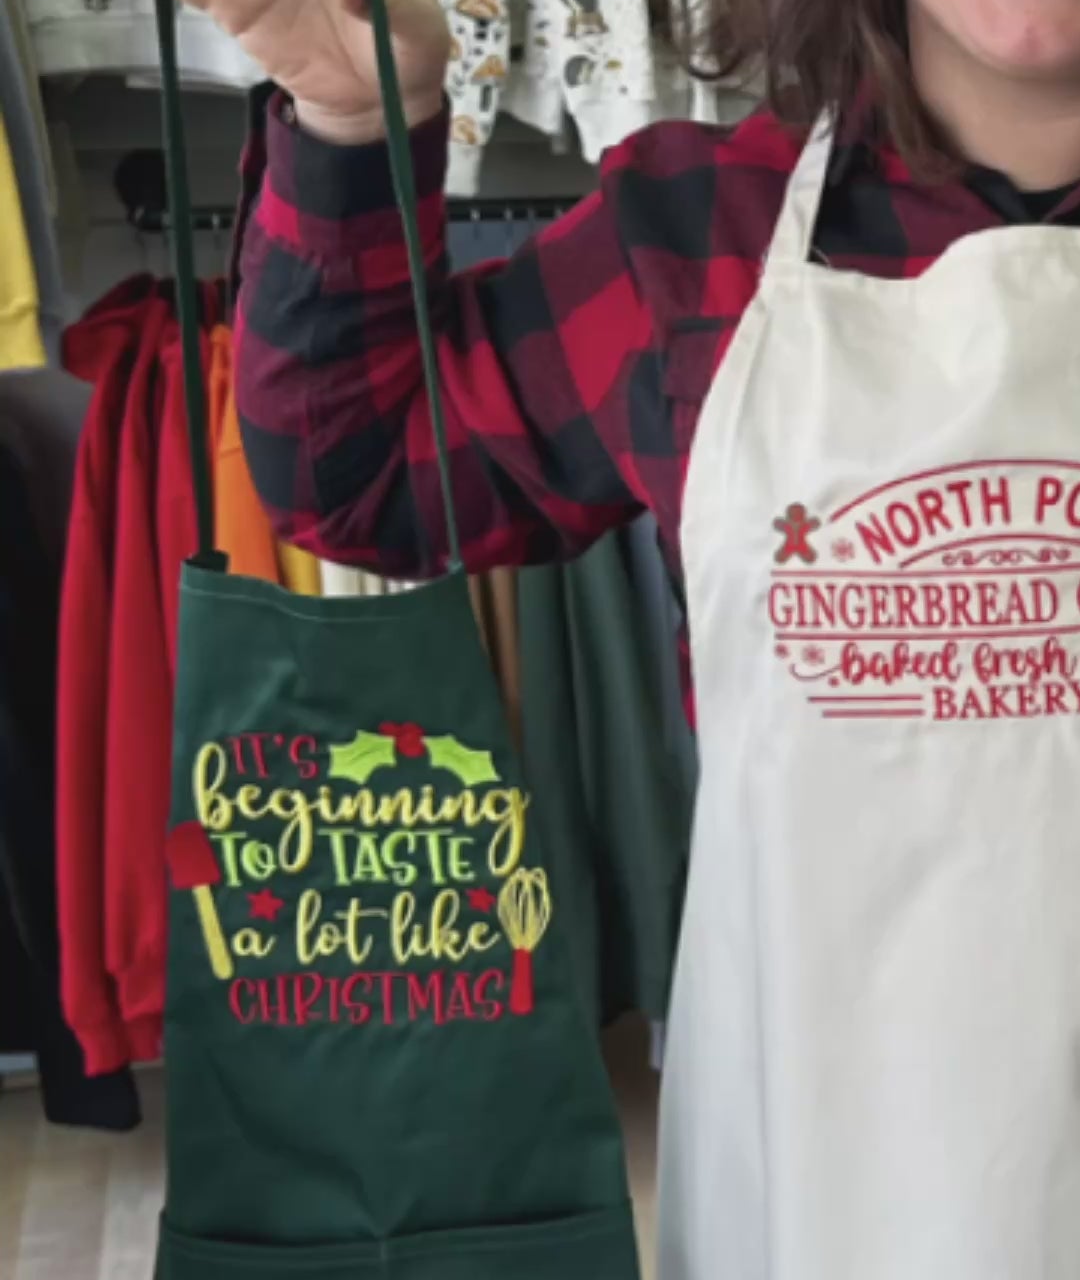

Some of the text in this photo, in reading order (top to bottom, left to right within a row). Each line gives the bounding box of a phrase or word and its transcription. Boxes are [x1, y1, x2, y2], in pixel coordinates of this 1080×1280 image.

[854, 477, 1011, 565] NORTH
[767, 578, 1059, 629] GINGERBREAD
[840, 640, 962, 684] baked
[972, 636, 1078, 685] fresh
[227, 732, 320, 780] IT'S
[192, 741, 531, 877] beginning
[209, 826, 477, 888] TO TASTE
[231, 888, 502, 965] a lot like
[228, 967, 506, 1026] CHRISTMAS
